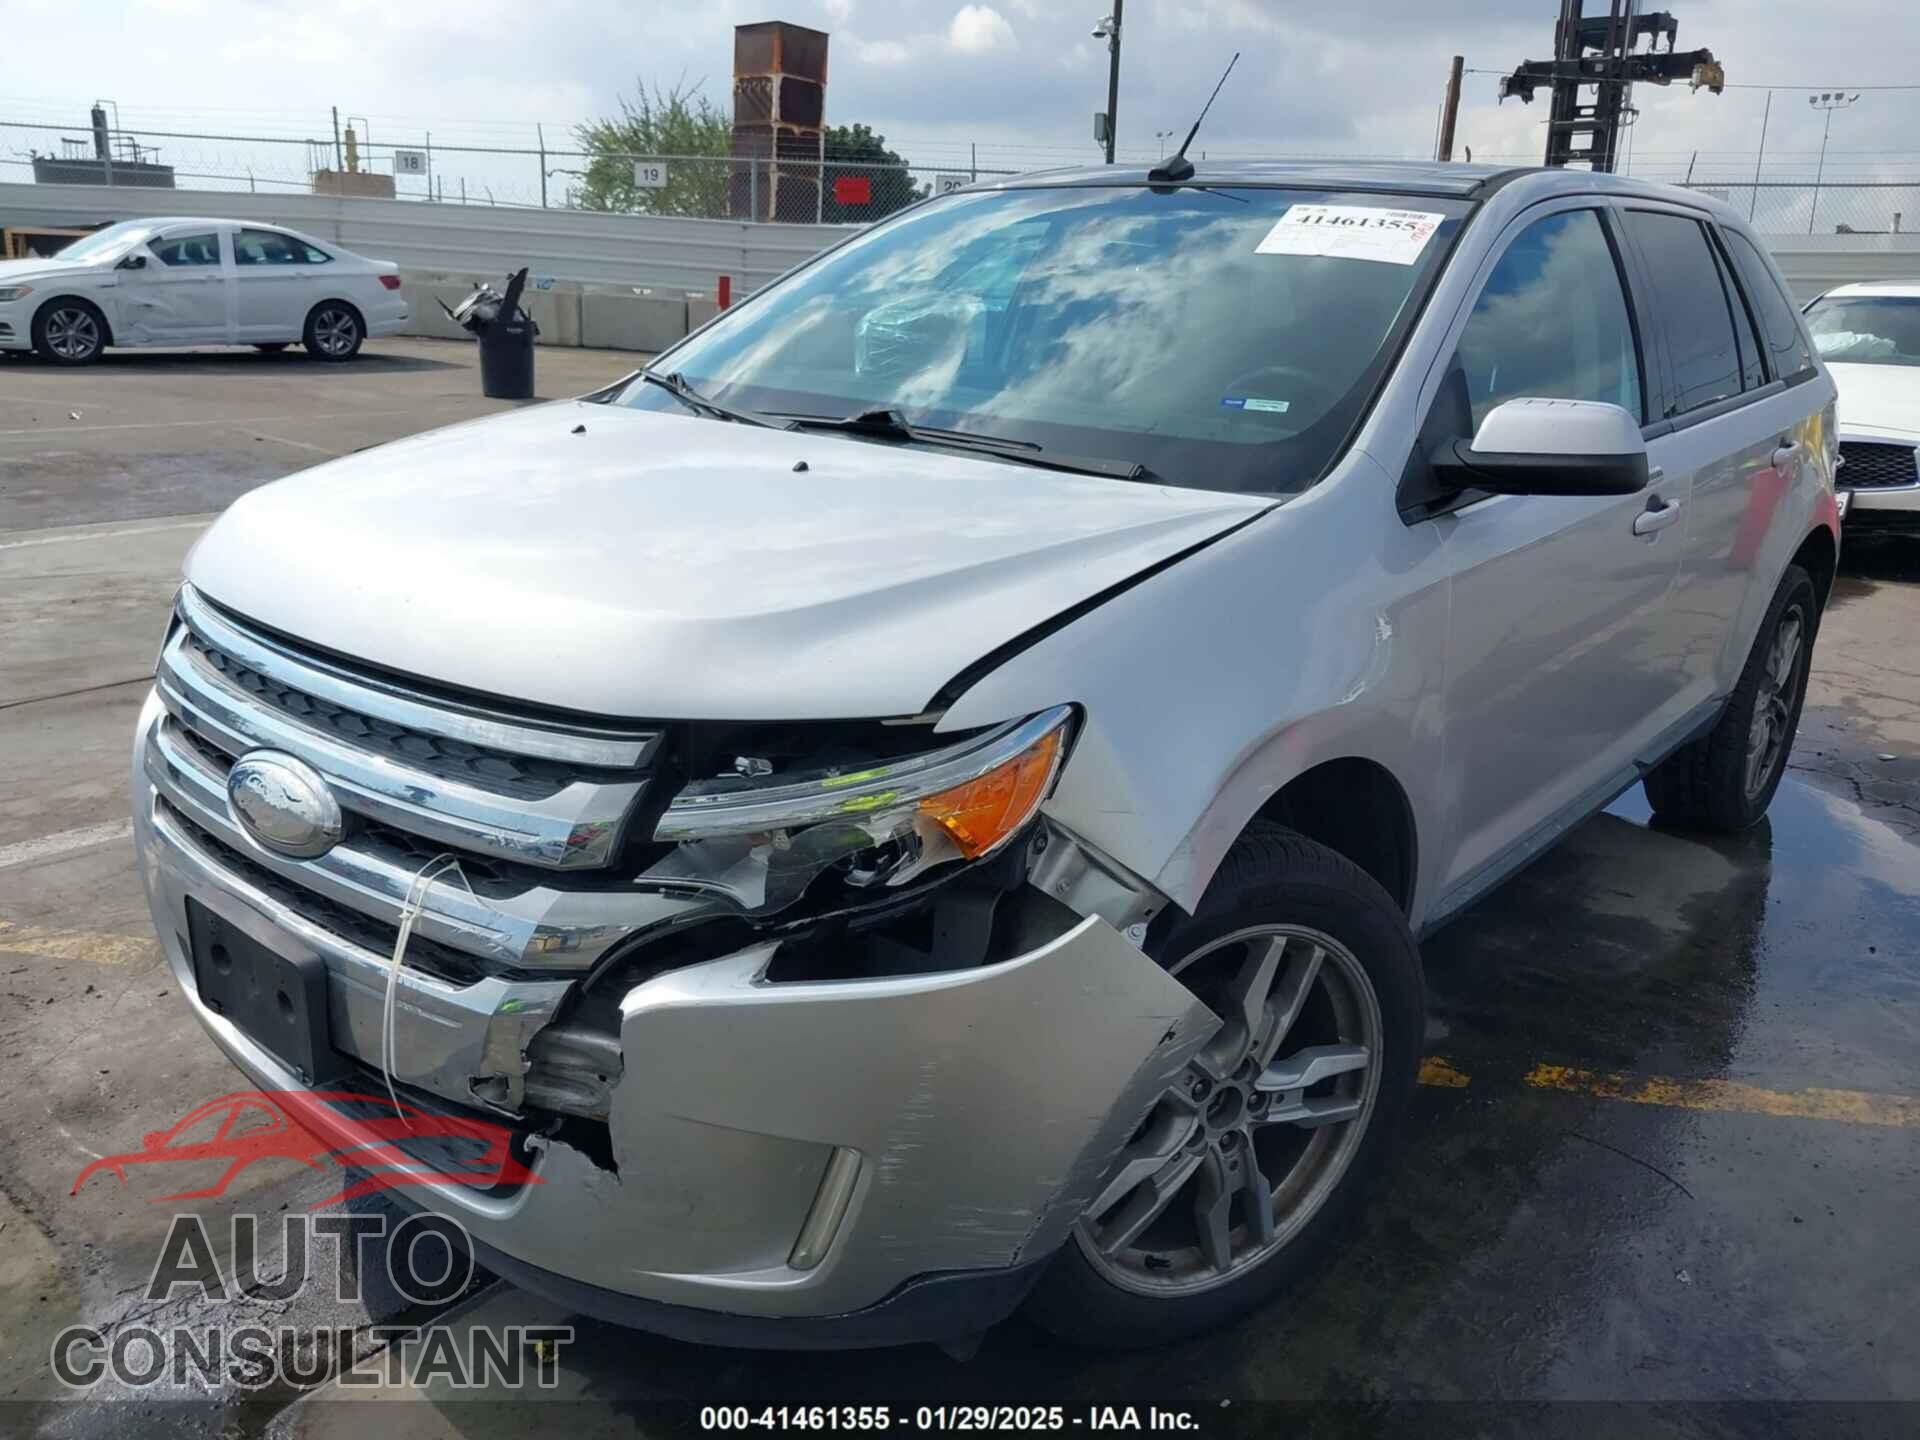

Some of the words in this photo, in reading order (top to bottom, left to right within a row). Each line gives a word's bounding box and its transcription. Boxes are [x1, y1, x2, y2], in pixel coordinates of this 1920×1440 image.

[403, 156, 418, 169] 18
[643, 167, 658, 181] 19
[1296, 214, 1417, 231] 41461355
